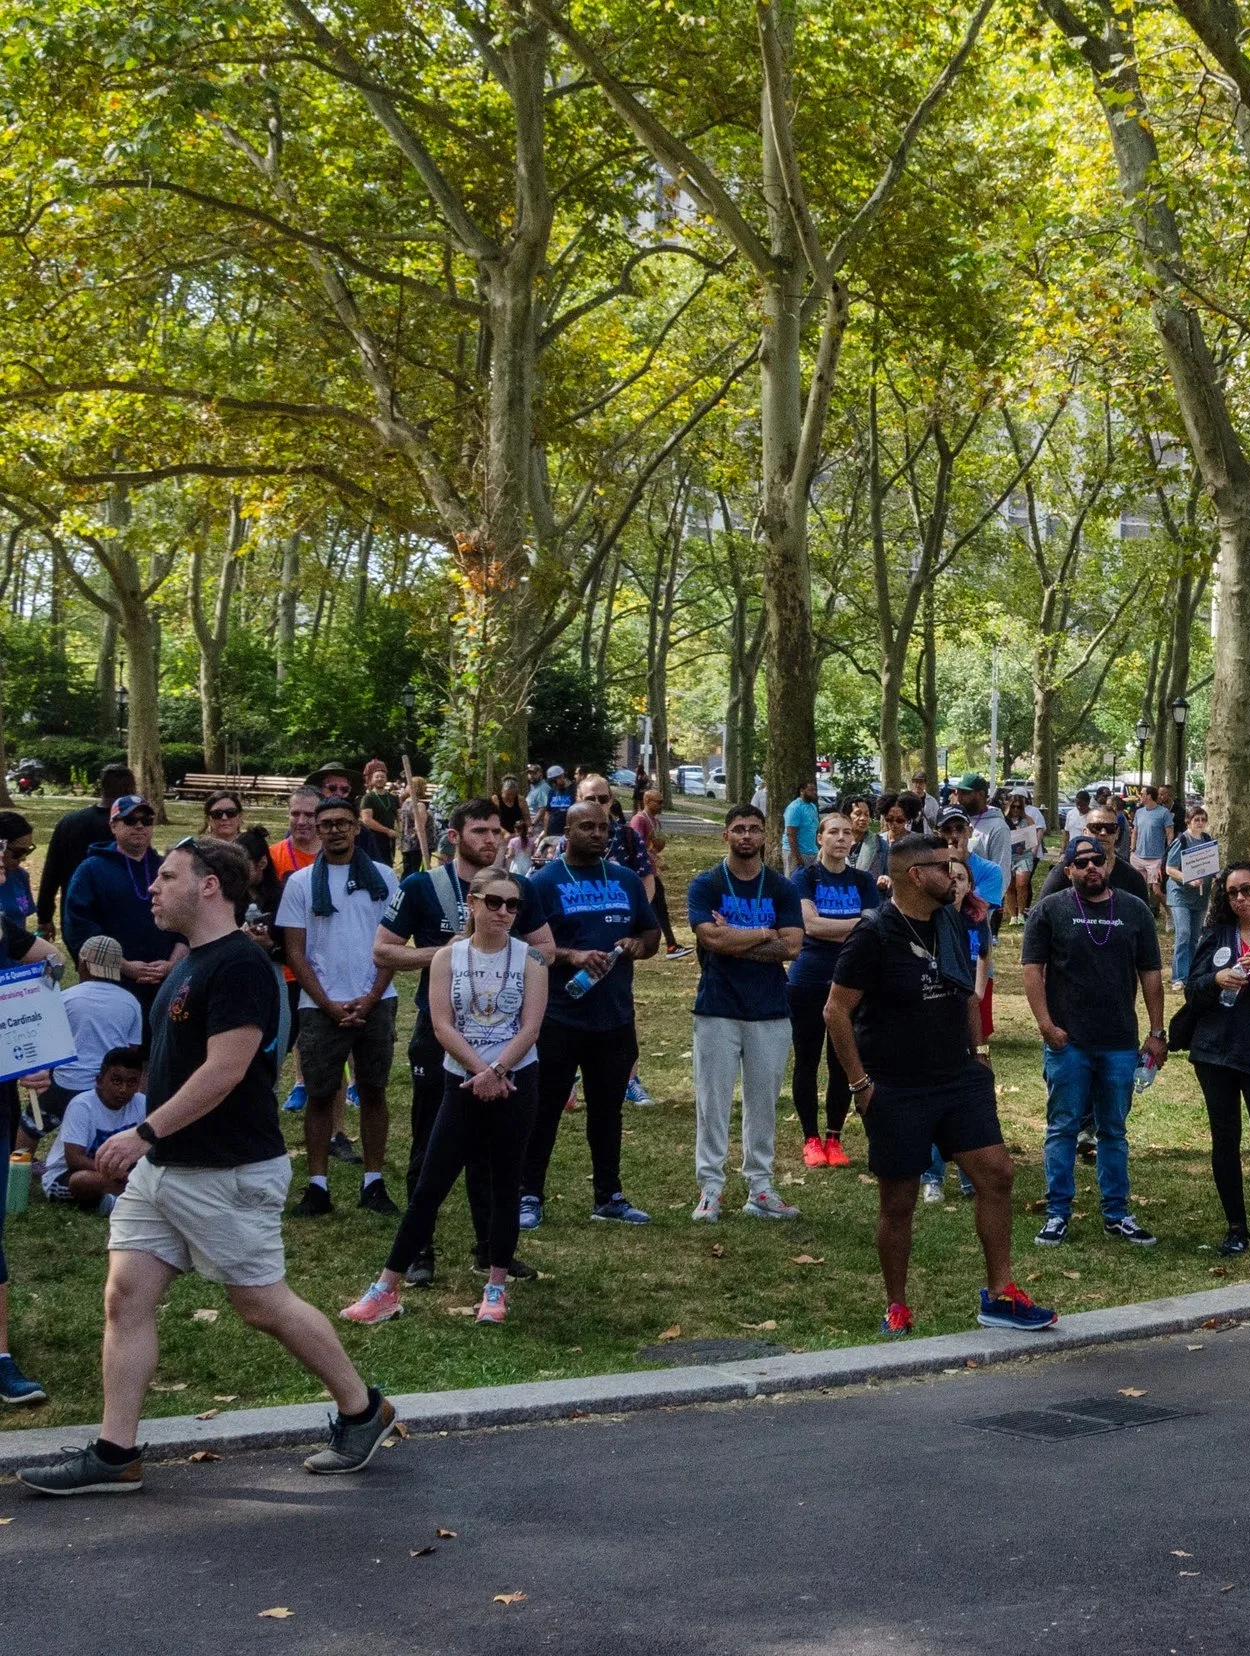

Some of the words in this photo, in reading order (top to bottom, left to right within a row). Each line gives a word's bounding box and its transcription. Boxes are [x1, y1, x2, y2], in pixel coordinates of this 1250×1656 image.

[556, 880, 620, 898] WALK
[562, 892, 605, 906] WITH
[607, 890, 627, 901] US
[757, 911, 775, 923] US
[456, 970, 486, 978] LIGHT
[496, 971, 521, 980] LOVE
[453, 978, 464, 1010] TRUTH
[7, 1011, 42, 1028] Cardinals
